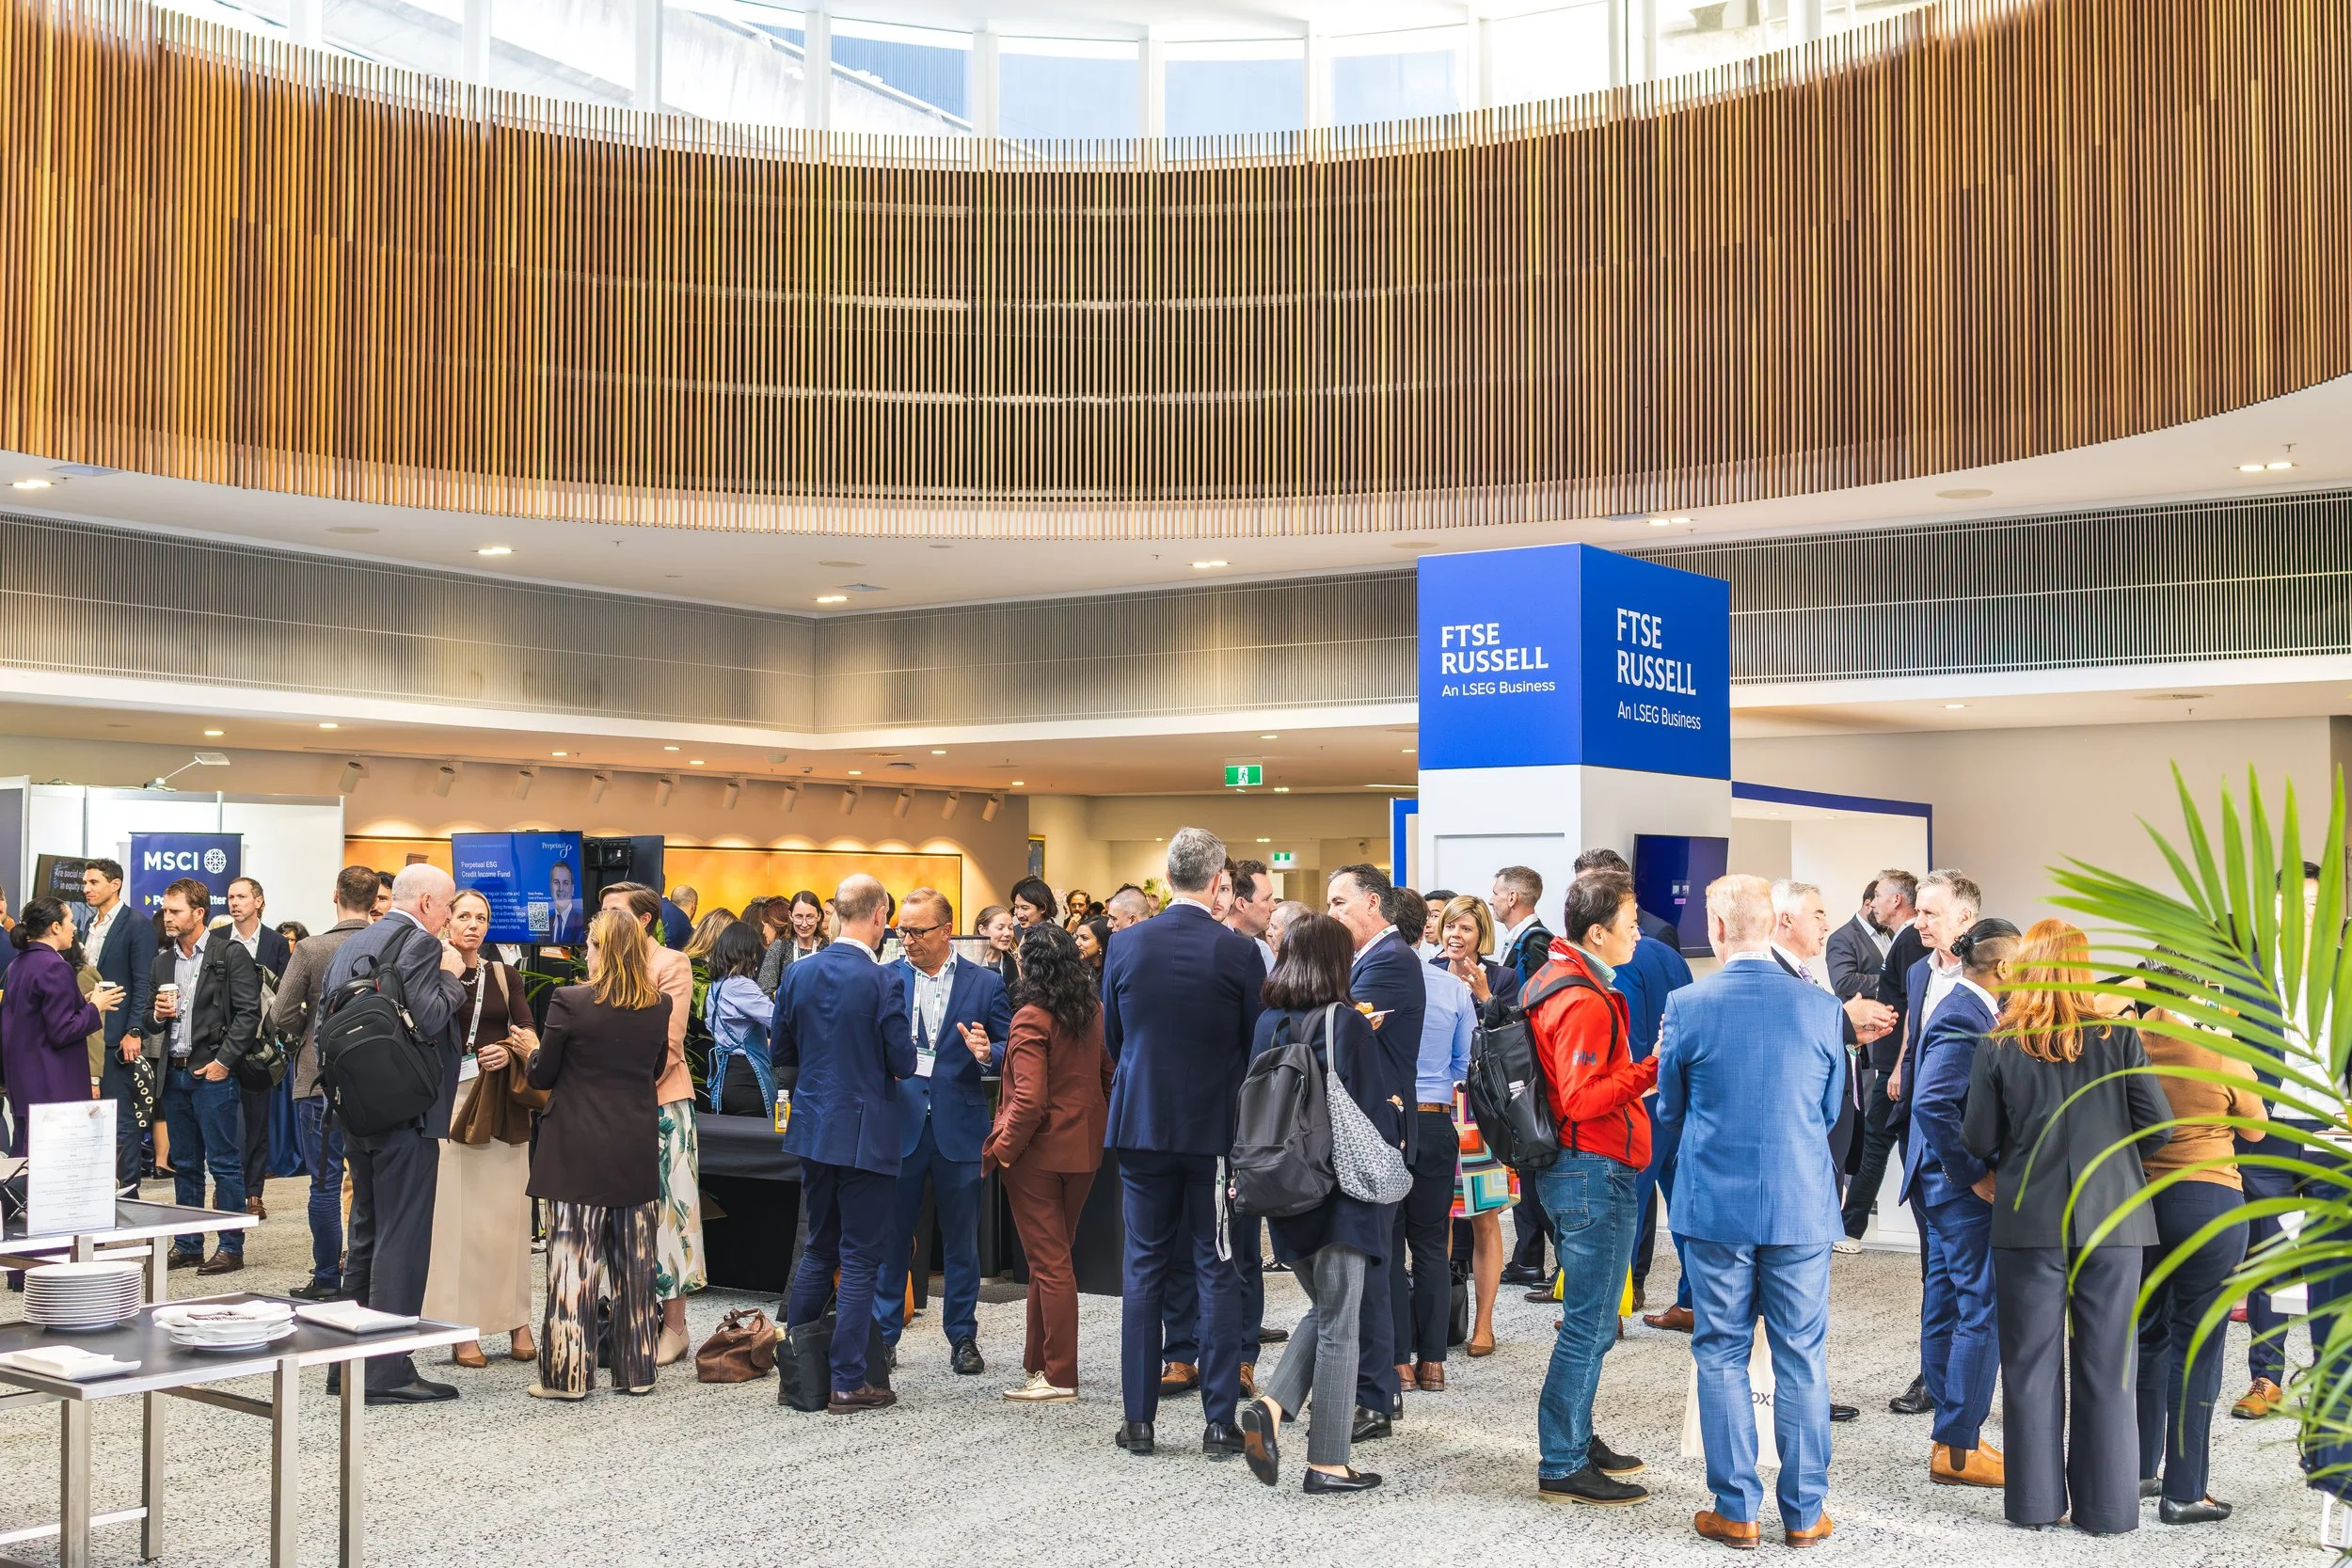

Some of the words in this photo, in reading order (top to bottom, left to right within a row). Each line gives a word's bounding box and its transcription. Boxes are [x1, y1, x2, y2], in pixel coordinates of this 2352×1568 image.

[1441, 623, 1500, 648] FTSE
[1616, 608, 1662, 650] FTSE
[1441, 647, 1549, 674] RUSSELL
[1616, 649, 1696, 696] RUSSELL
[1441, 684, 1459, 697] An
[1462, 682, 1496, 696] LSEG
[1499, 680, 1556, 694] Business
[1617, 701, 1631, 720] An
[1633, 703, 1660, 724] LSEG
[1661, 706, 1701, 730] Business
[542, 842, 566, 850] Perpetual
[144, 851, 199, 871] MSCI
[461, 861, 485, 869] Perpetual
[64, 869, 79, 879] social
